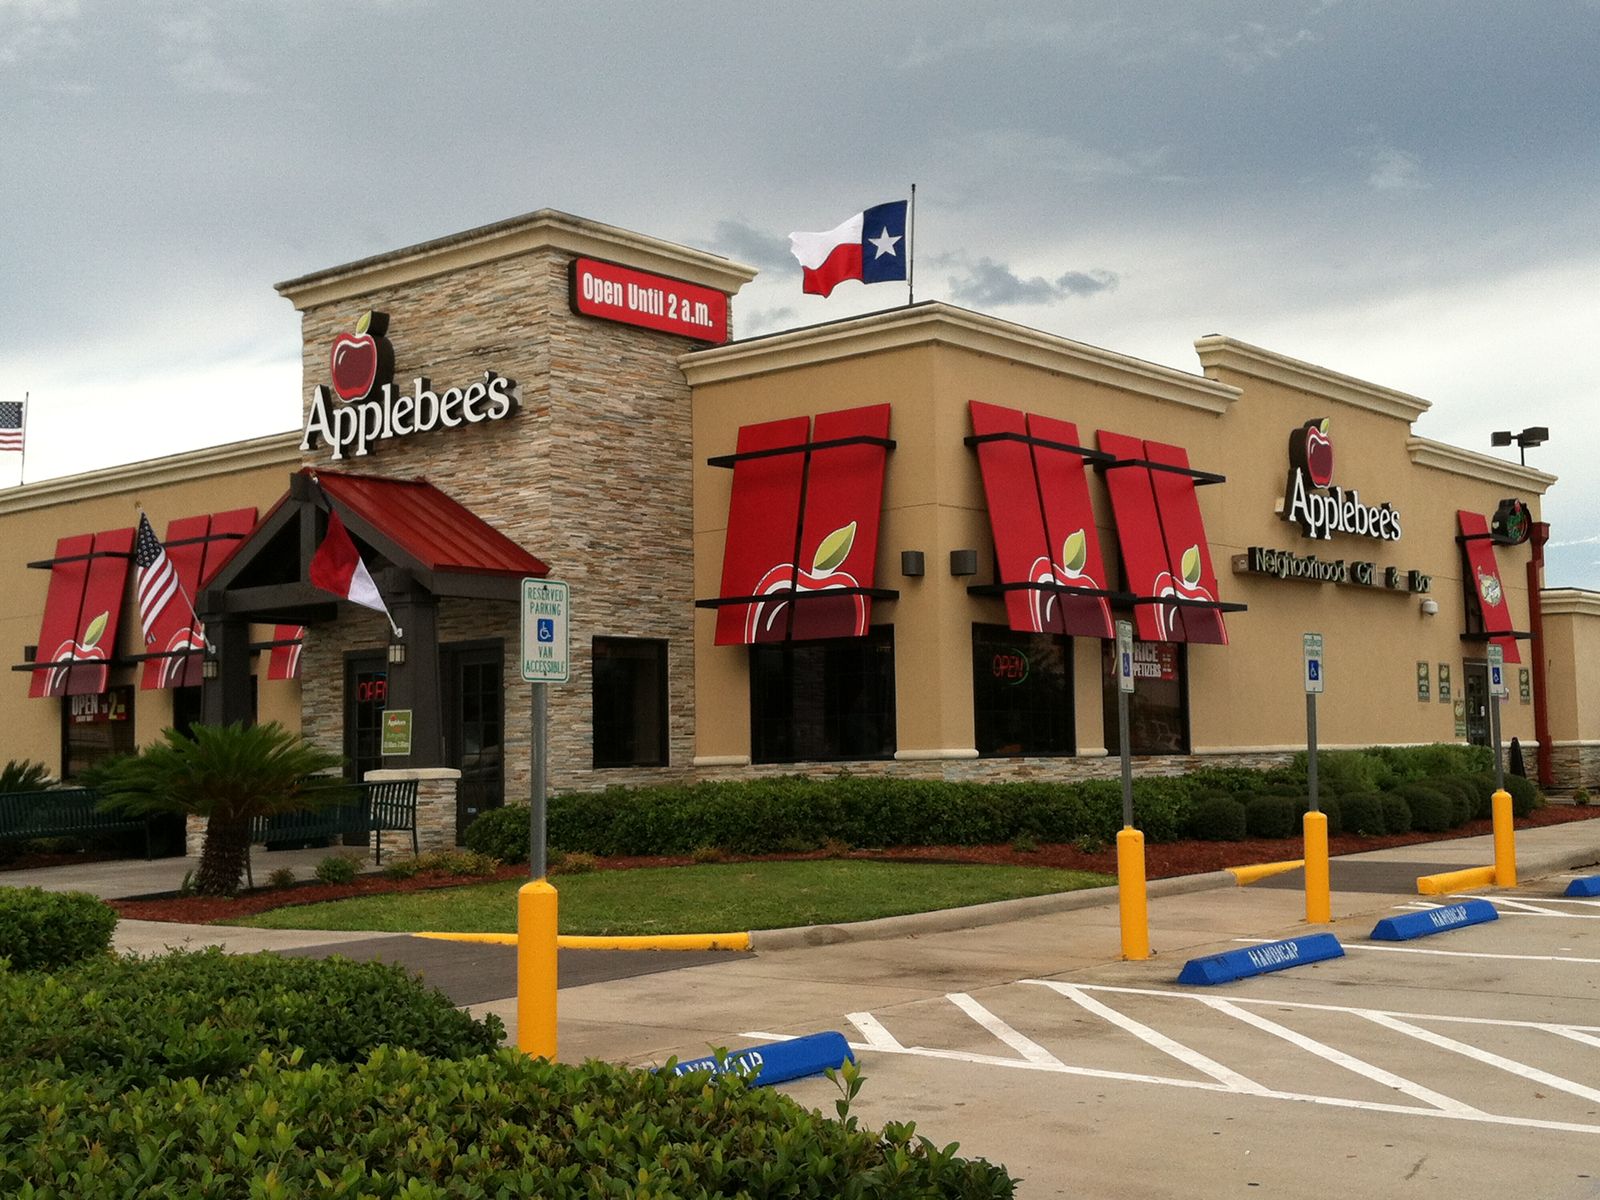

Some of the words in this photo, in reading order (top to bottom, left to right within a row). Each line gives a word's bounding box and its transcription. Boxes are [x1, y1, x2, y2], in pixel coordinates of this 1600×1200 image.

[583, 272, 623, 307] Open
[628, 283, 664, 316] Until
[668, 293, 678, 320] 2
[681, 299, 713, 328] a.m.
[300, 370, 510, 460] Applebee's
[1289, 467, 1401, 541] Applebee's
[1255, 549, 1347, 582] Neighborhood
[528, 587, 563, 601] RESERVED
[530, 602, 561, 616] PARKING
[538, 646, 553, 658] VAN
[1134, 642, 1159, 662] RICE
[525, 660, 566, 674] ACCESSIBLE
[72, 694, 98, 715] OPEN
[1429, 906, 1467, 927] HANDICAP
[1248, 942, 1299, 969] HANDICAP
